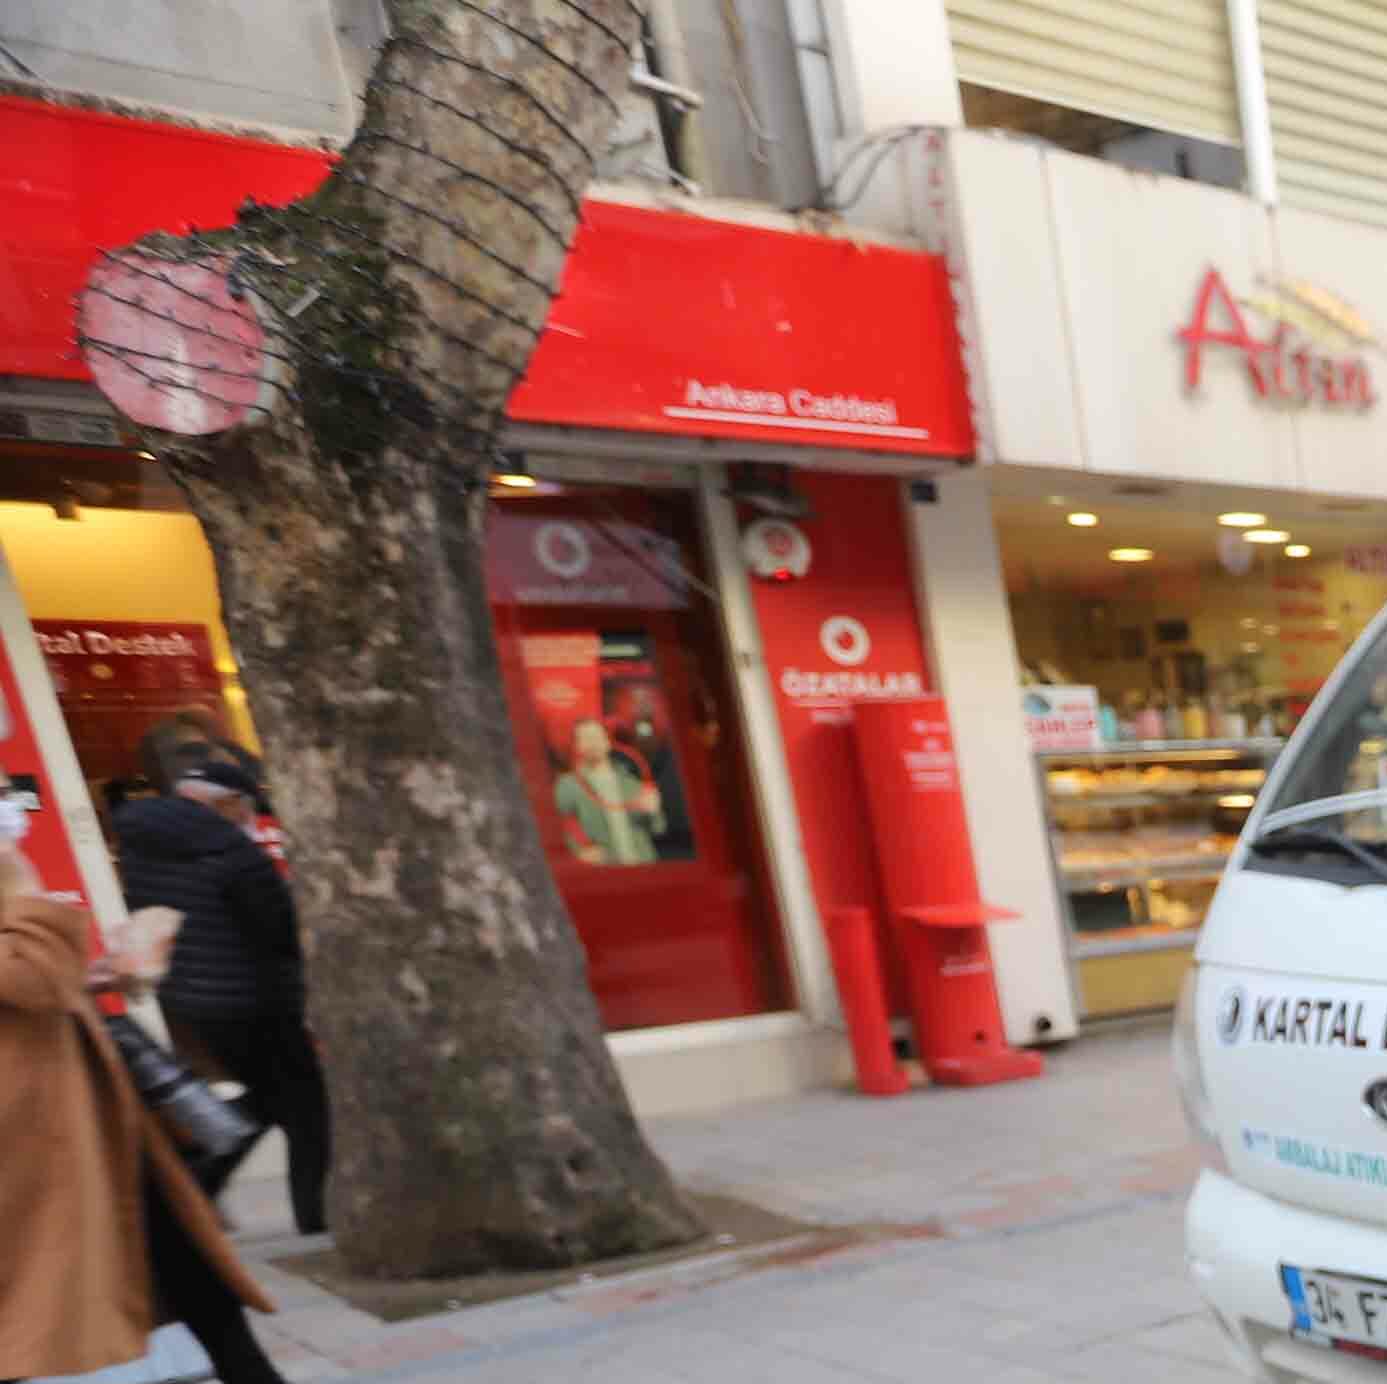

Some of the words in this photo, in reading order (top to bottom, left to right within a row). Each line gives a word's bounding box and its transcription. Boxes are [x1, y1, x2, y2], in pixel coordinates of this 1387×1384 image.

[687, 379, 787, 416] Ankara
[1253, 994, 1368, 1048] KARTAL
[1306, 1279, 1346, 1330] 34
